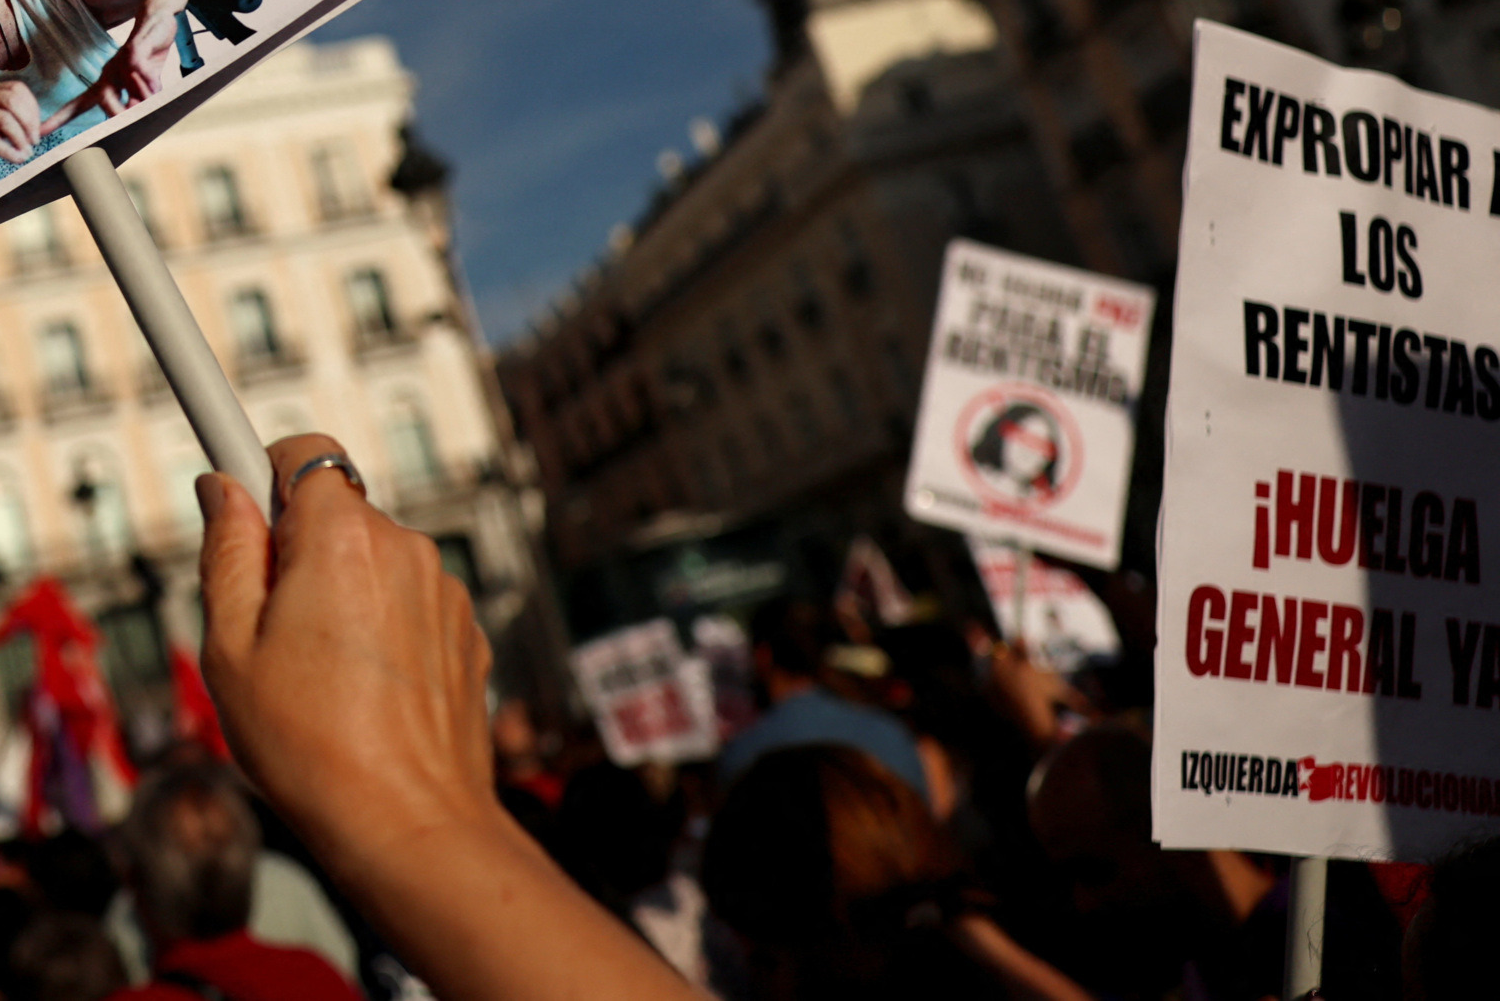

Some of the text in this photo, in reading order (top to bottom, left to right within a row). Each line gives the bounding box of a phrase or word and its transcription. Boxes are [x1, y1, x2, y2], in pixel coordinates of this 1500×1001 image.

[1220, 77, 1470, 212] EXPROPIAR
[1339, 211, 1423, 300] LOS
[1243, 299, 1500, 423] RENTISTAS
[1252, 468, 1481, 585] ¡HUELGA
[1185, 583, 1500, 710] GENERAL YA
[1181, 750, 1299, 796] IZQUIERDA
